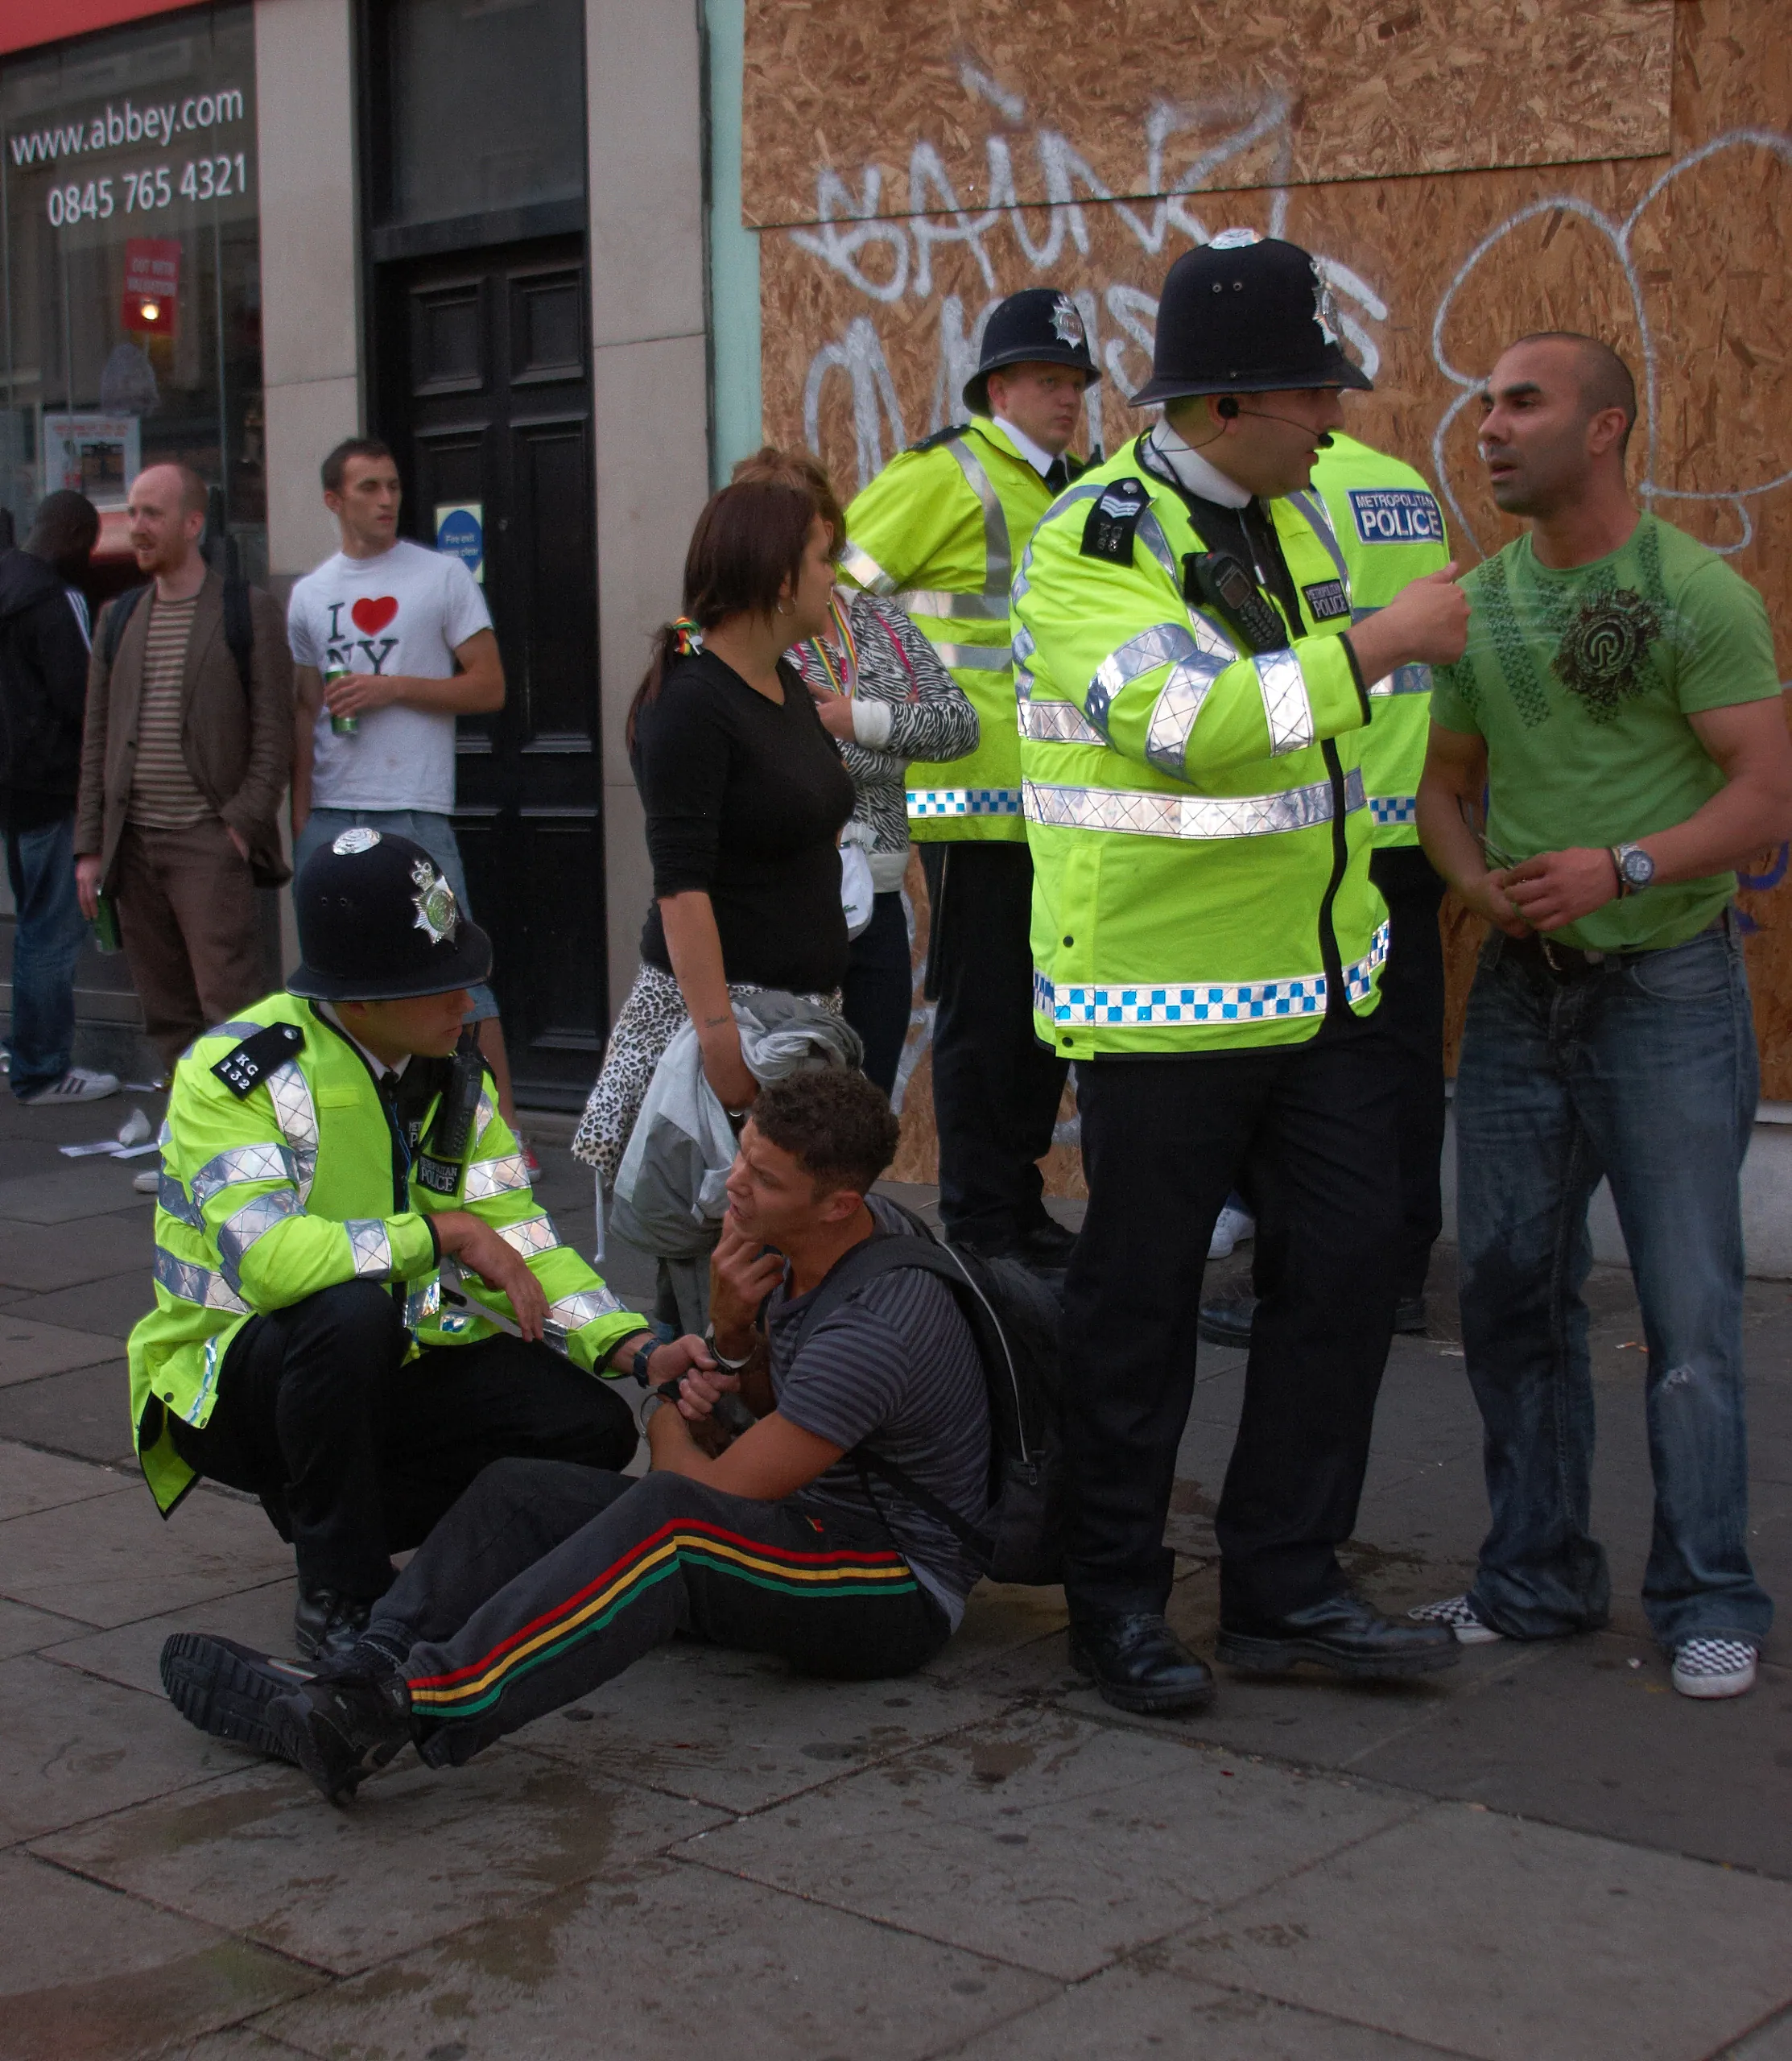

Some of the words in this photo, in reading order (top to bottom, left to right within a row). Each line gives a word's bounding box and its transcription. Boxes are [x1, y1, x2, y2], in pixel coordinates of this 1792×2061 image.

[10, 89, 243, 165] www.abbey.com
[47, 177, 114, 227] 0845
[122, 166, 171, 213] 765
[180, 152, 246, 201] 4321
[1355, 494, 1434, 509] METROPOLITAN
[1361, 509, 1442, 537] POLICE
[1312, 594, 1347, 617] POLICE
[328, 602, 345, 643] I
[221, 1062, 250, 1090] 132
[235, 1053, 258, 1076] KG
[420, 1166, 455, 1192] POLICE
